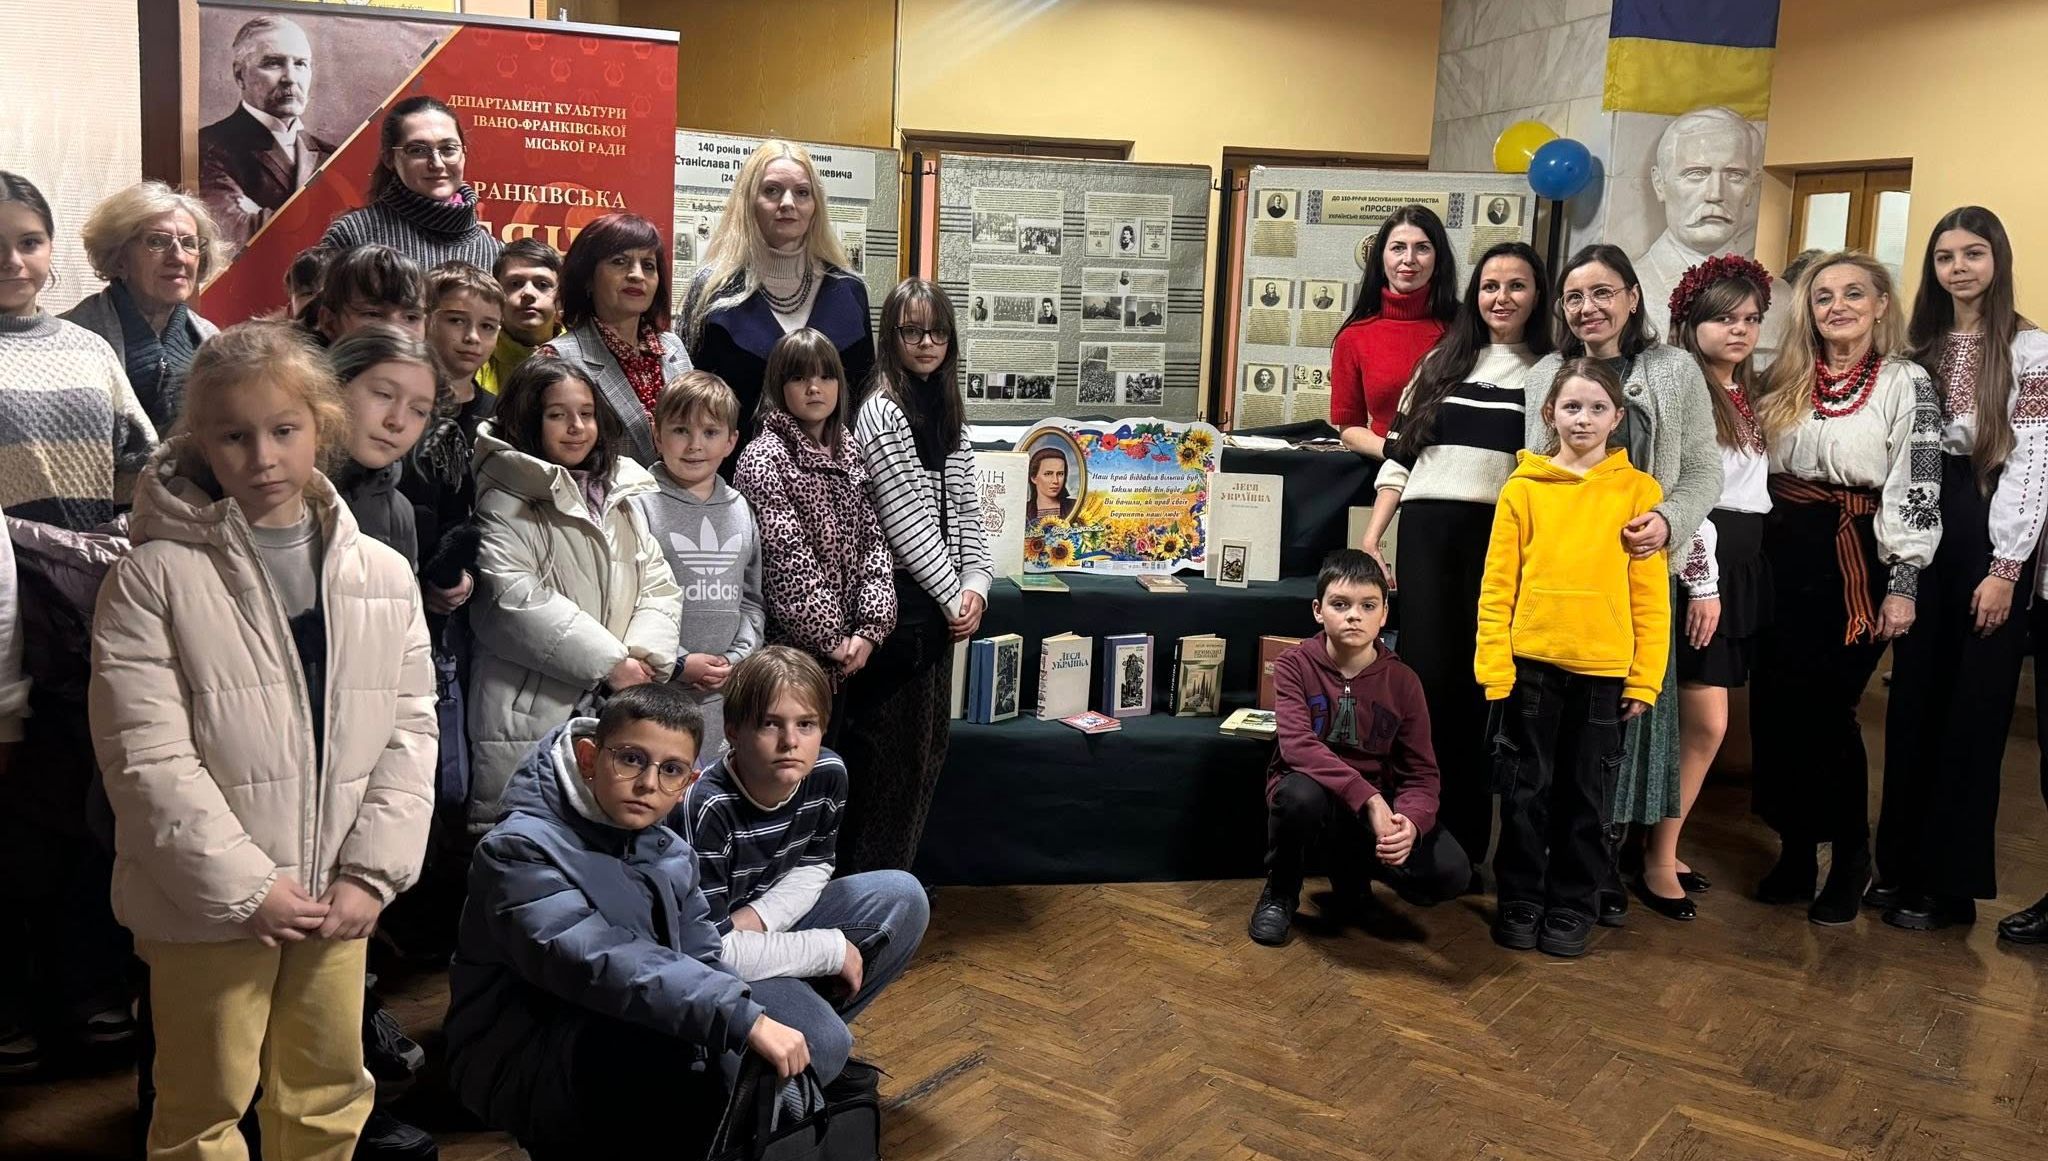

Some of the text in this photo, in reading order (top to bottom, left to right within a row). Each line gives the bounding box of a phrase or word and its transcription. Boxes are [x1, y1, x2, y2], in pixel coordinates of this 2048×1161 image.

[447, 94, 627, 119] ДЕПАРТАМЕНТ КУЛЬТУРИ
[474, 115, 627, 137] ІВАНО-ФРАНКІВСЬКОЇ
[525, 137, 626, 156] МІСЬКОЇ РАДИ
[698, 142, 714, 152] 140
[716, 145, 741, 154] років
[675, 155, 730, 169] Станіслава
[819, 169, 852, 179] кевича
[465, 180, 627, 209] РАНКІВСЬКА
[682, 579, 739, 601] didas
